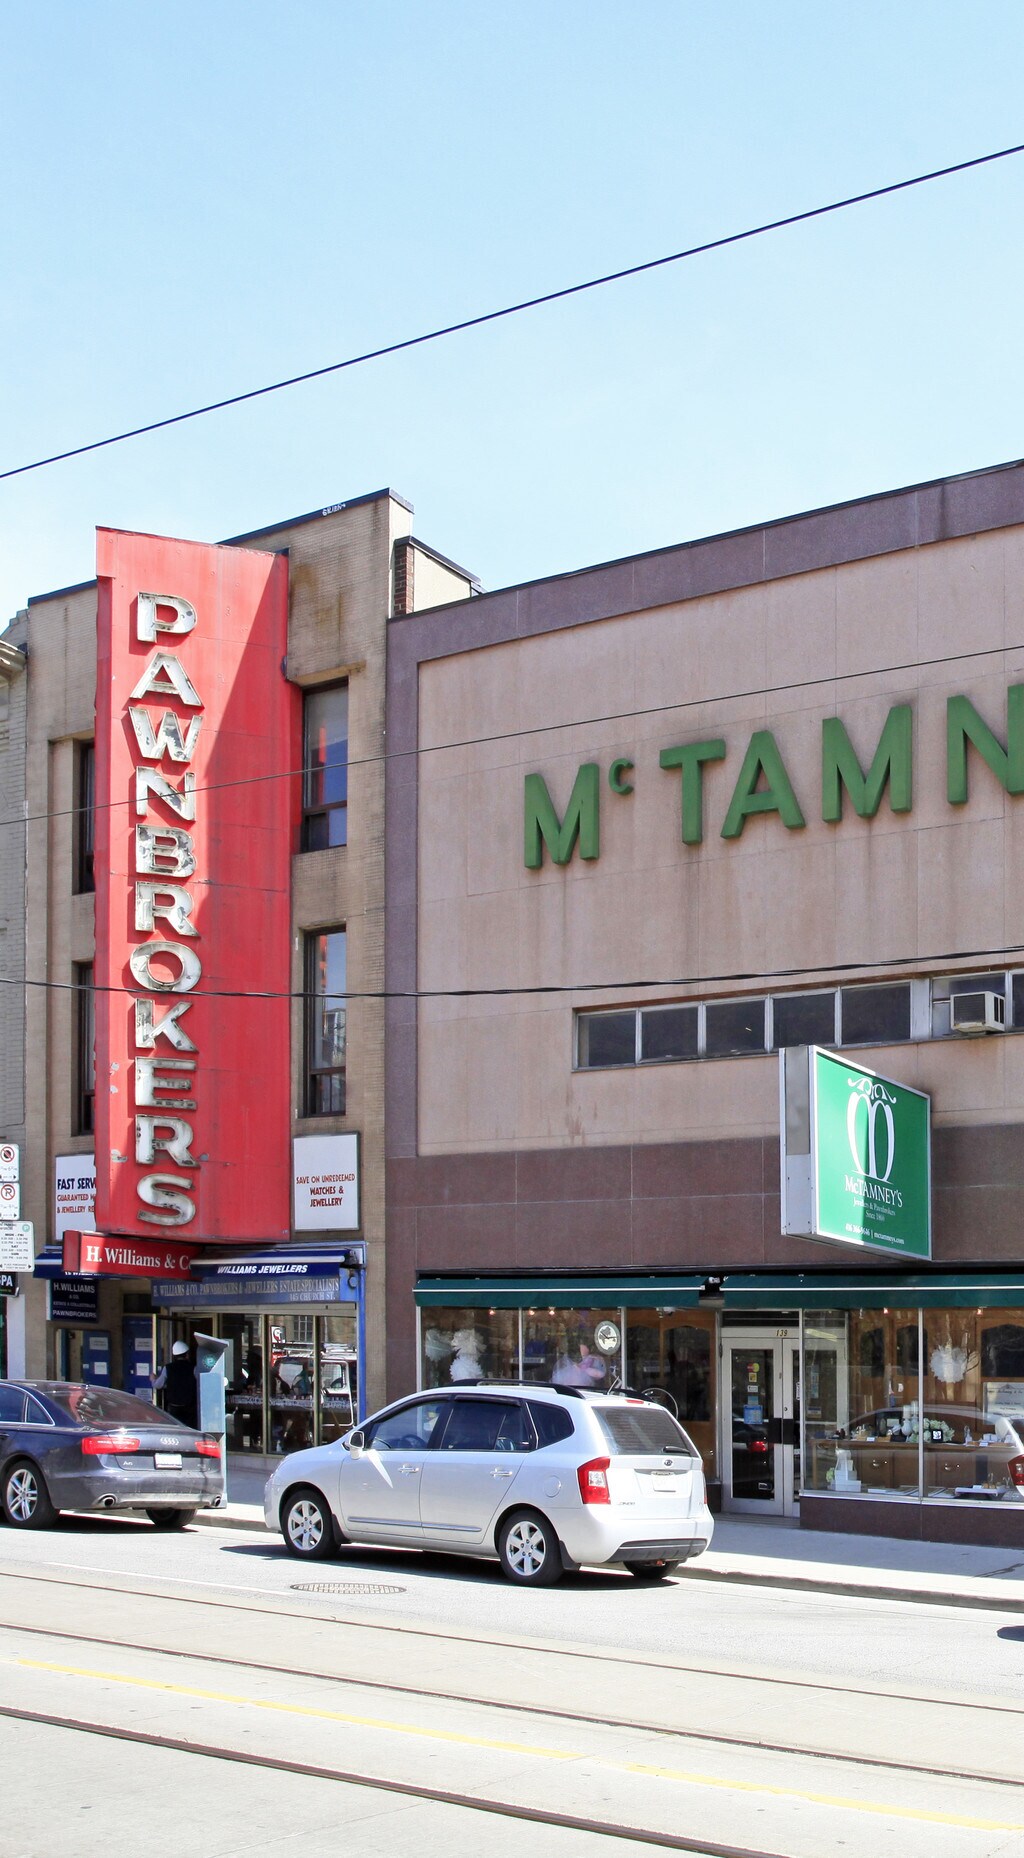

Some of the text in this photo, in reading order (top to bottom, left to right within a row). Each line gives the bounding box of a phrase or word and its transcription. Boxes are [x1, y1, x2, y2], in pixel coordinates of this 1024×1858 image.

[127, 591, 204, 1228] PAWNBROKERS
[57, 1177, 97, 1190] FAST SERV
[296, 1173, 356, 1184] SAVE ON UNREDEEMED
[310, 1186, 344, 1195] WATCHES &
[844, 1174, 903, 1208] McTAMNEY'S
[310, 1197, 343, 1207] JEWELLERY
[86, 1245, 103, 1262] H.
[104, 1247, 161, 1268] Williams
[164, 1253, 176, 1269] &
[217, 1264, 308, 1275] WILLIAMS JEWELLERS
[326, 1291, 336, 1301] ST.
[53, 1309, 97, 1319] PAWNBROKERS
[776, 1329, 788, 1337] 139
